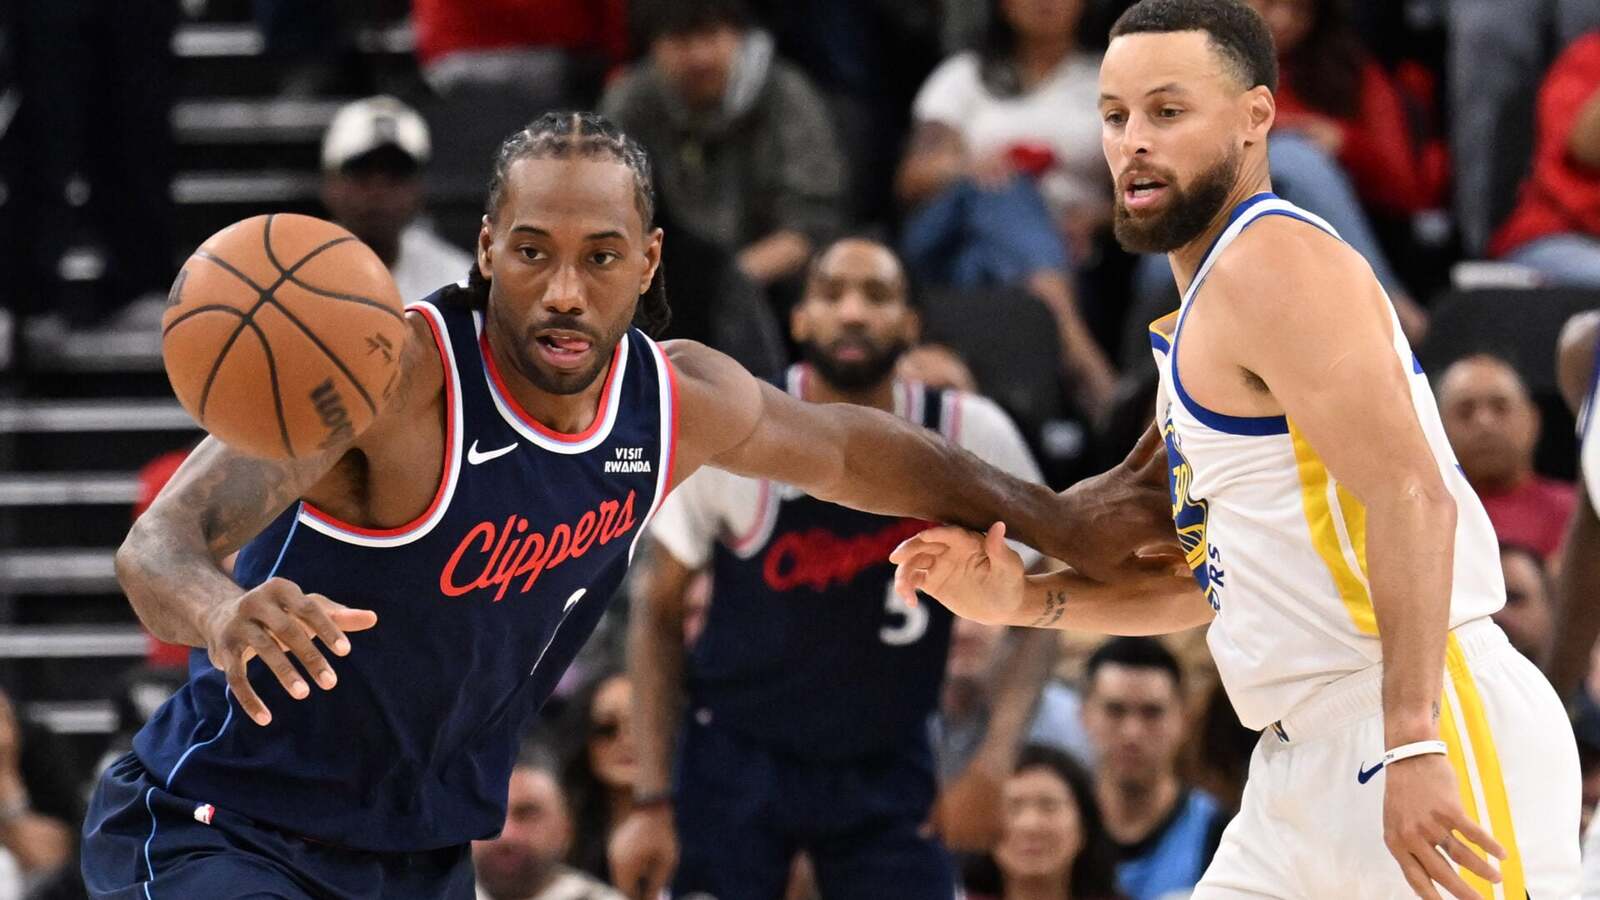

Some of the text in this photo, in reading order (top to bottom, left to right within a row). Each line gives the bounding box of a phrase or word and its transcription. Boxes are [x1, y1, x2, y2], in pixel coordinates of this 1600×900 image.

[604, 460, 651, 473] RWANDA
[615, 447, 643, 460] VISIT
[440, 488, 637, 602] Clippers
[880, 579, 930, 646] 5
